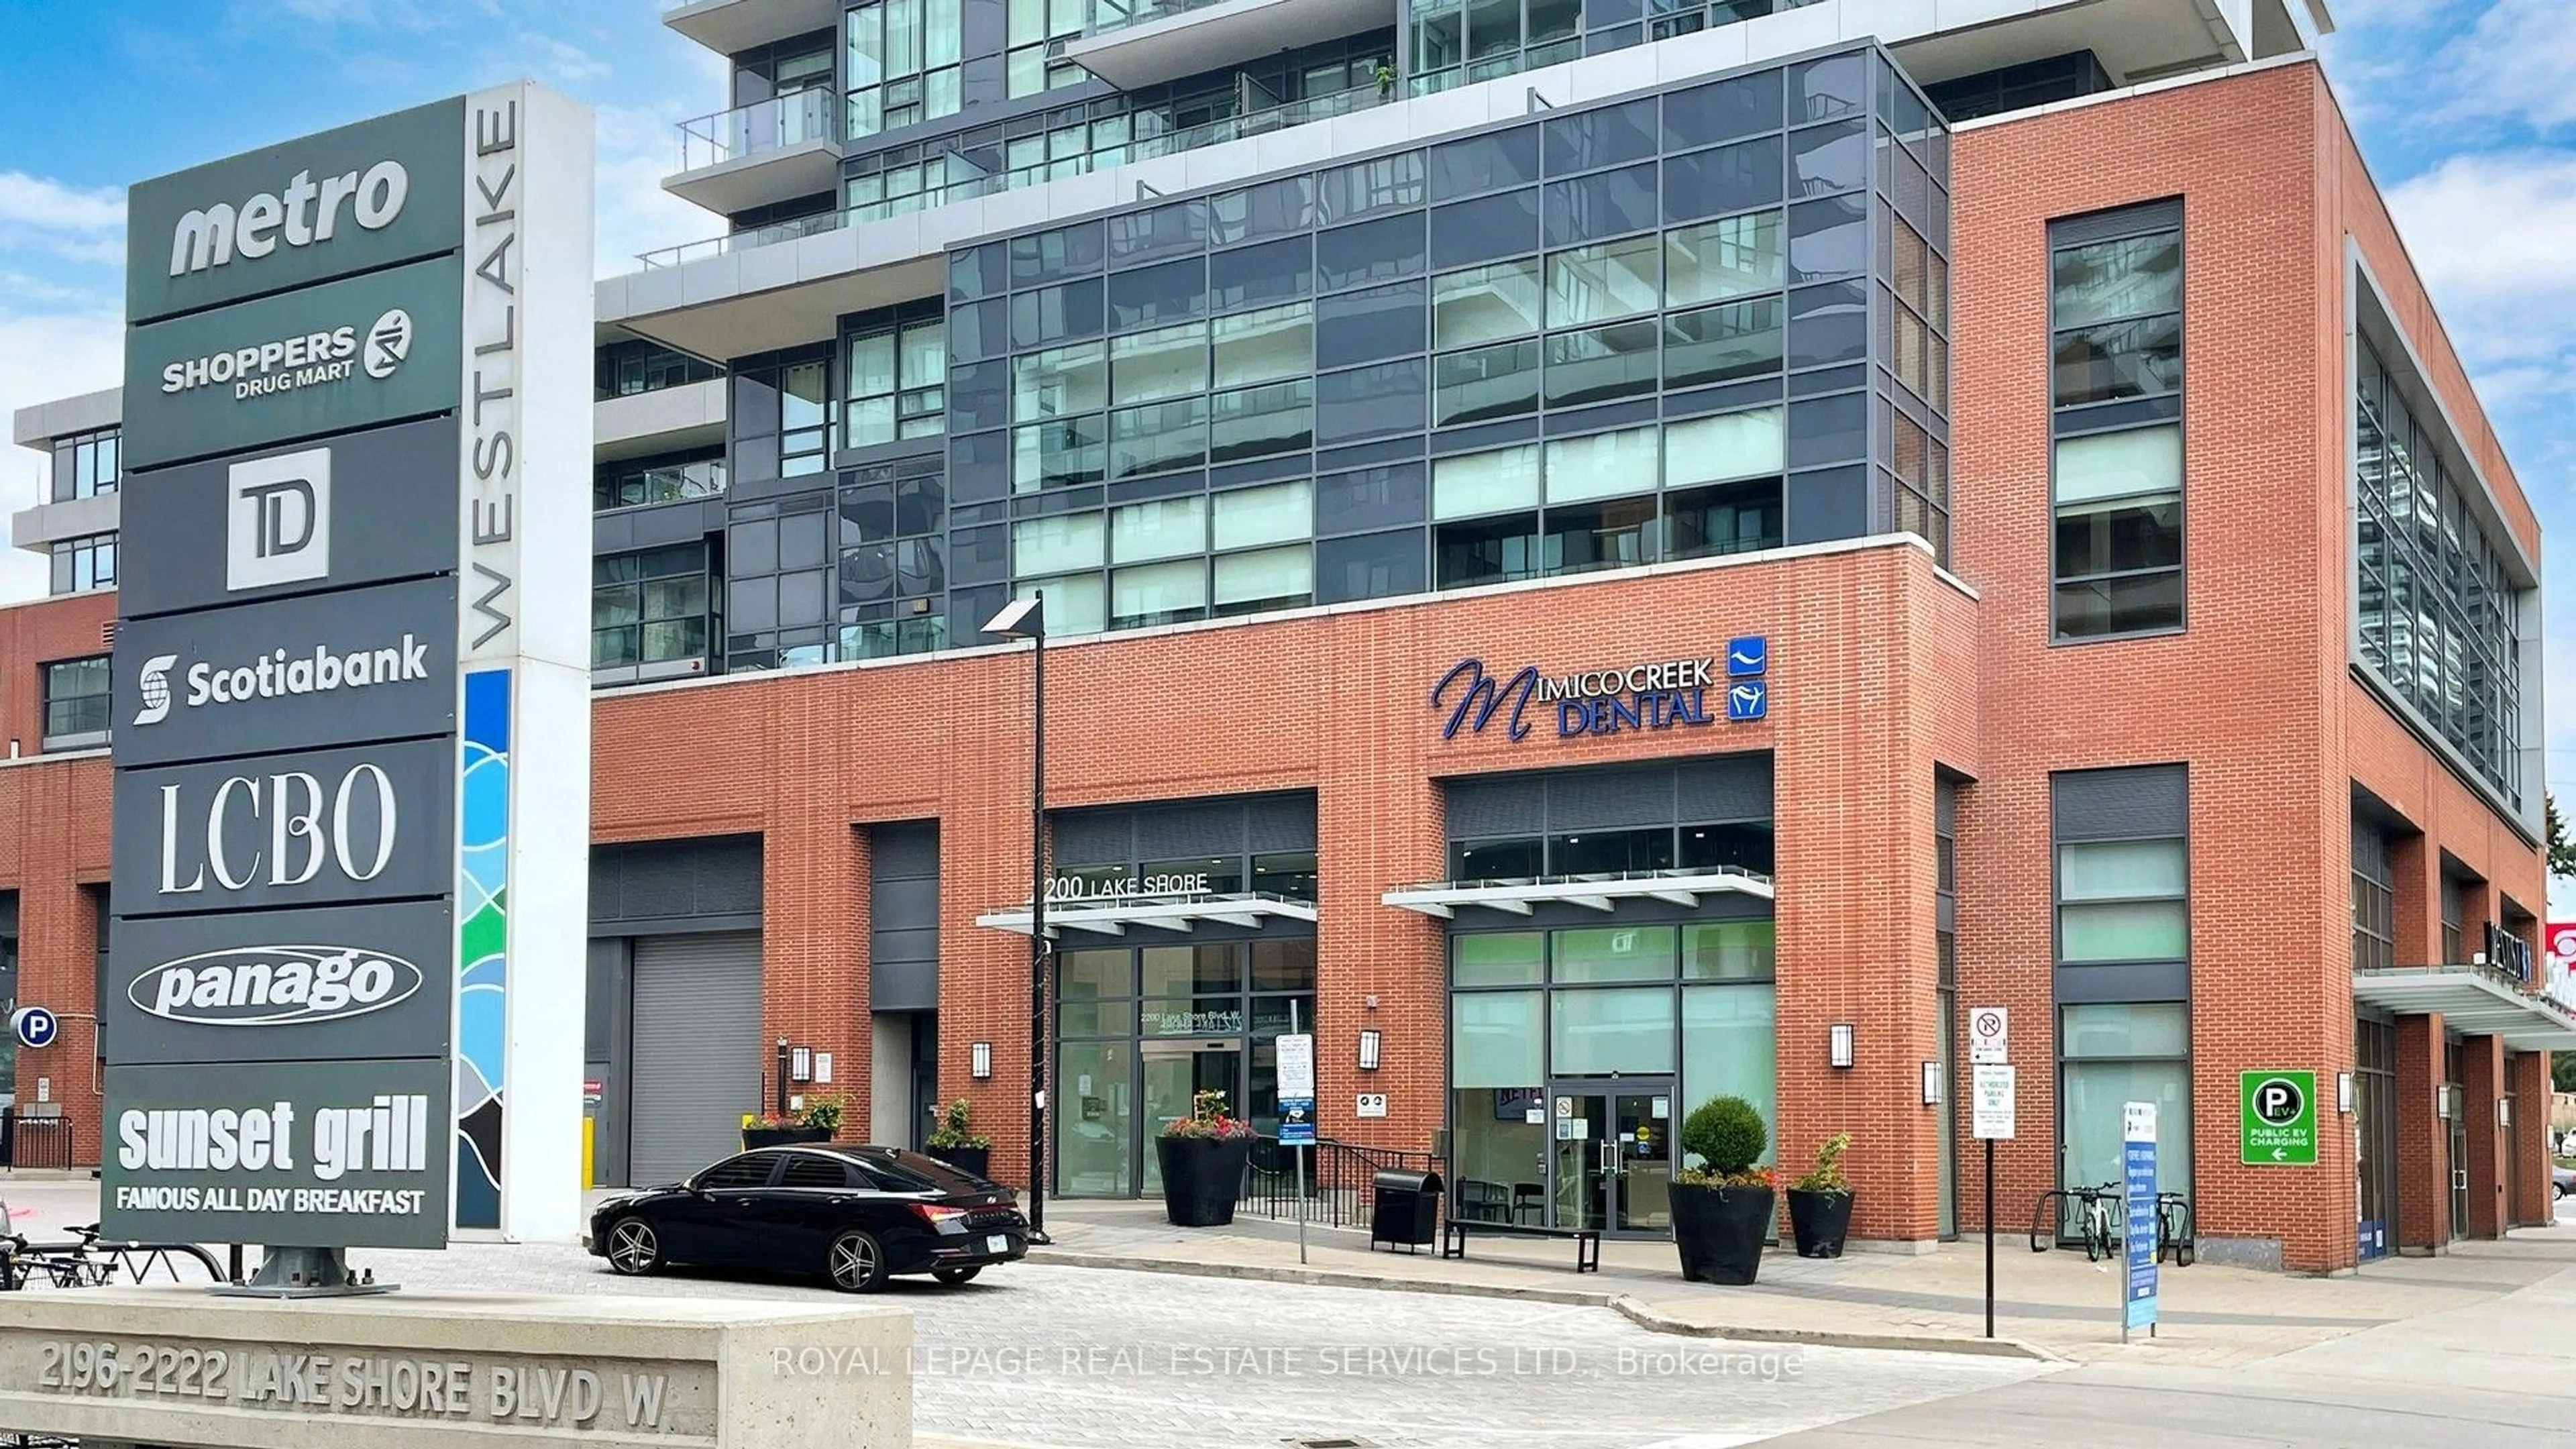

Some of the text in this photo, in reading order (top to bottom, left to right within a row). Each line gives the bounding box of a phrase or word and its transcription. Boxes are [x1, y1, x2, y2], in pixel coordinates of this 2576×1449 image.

[170, 160, 410, 277] metro
[161, 325, 357, 393] SHOPPERS
[235, 359, 355, 400] DRUG MART
[471, 99, 516, 650] WESTLAKE
[240, 478, 316, 558] TD
[186, 634, 429, 707] Scotiabank
[1556, 687, 1715, 737] DENTAL
[158, 763, 397, 894] LCBO
[1031, 873, 1208, 900] 200 LAKE SHORE
[154, 949, 395, 1016] panago
[30, 1016, 49, 1038] P
[2250, 1128, 2308, 1137] PUBLIC EV
[2266, 1087, 2288, 1117] P
[118, 1094, 428, 1181] sunset grill
[2249, 1138, 2308, 1146] CHARGING
[116, 1186, 426, 1215] FAMOUS ALL DAY BREAKFAST
[39, 1340, 668, 1428] 2196-2222 LAKE SHORE BLVD W
